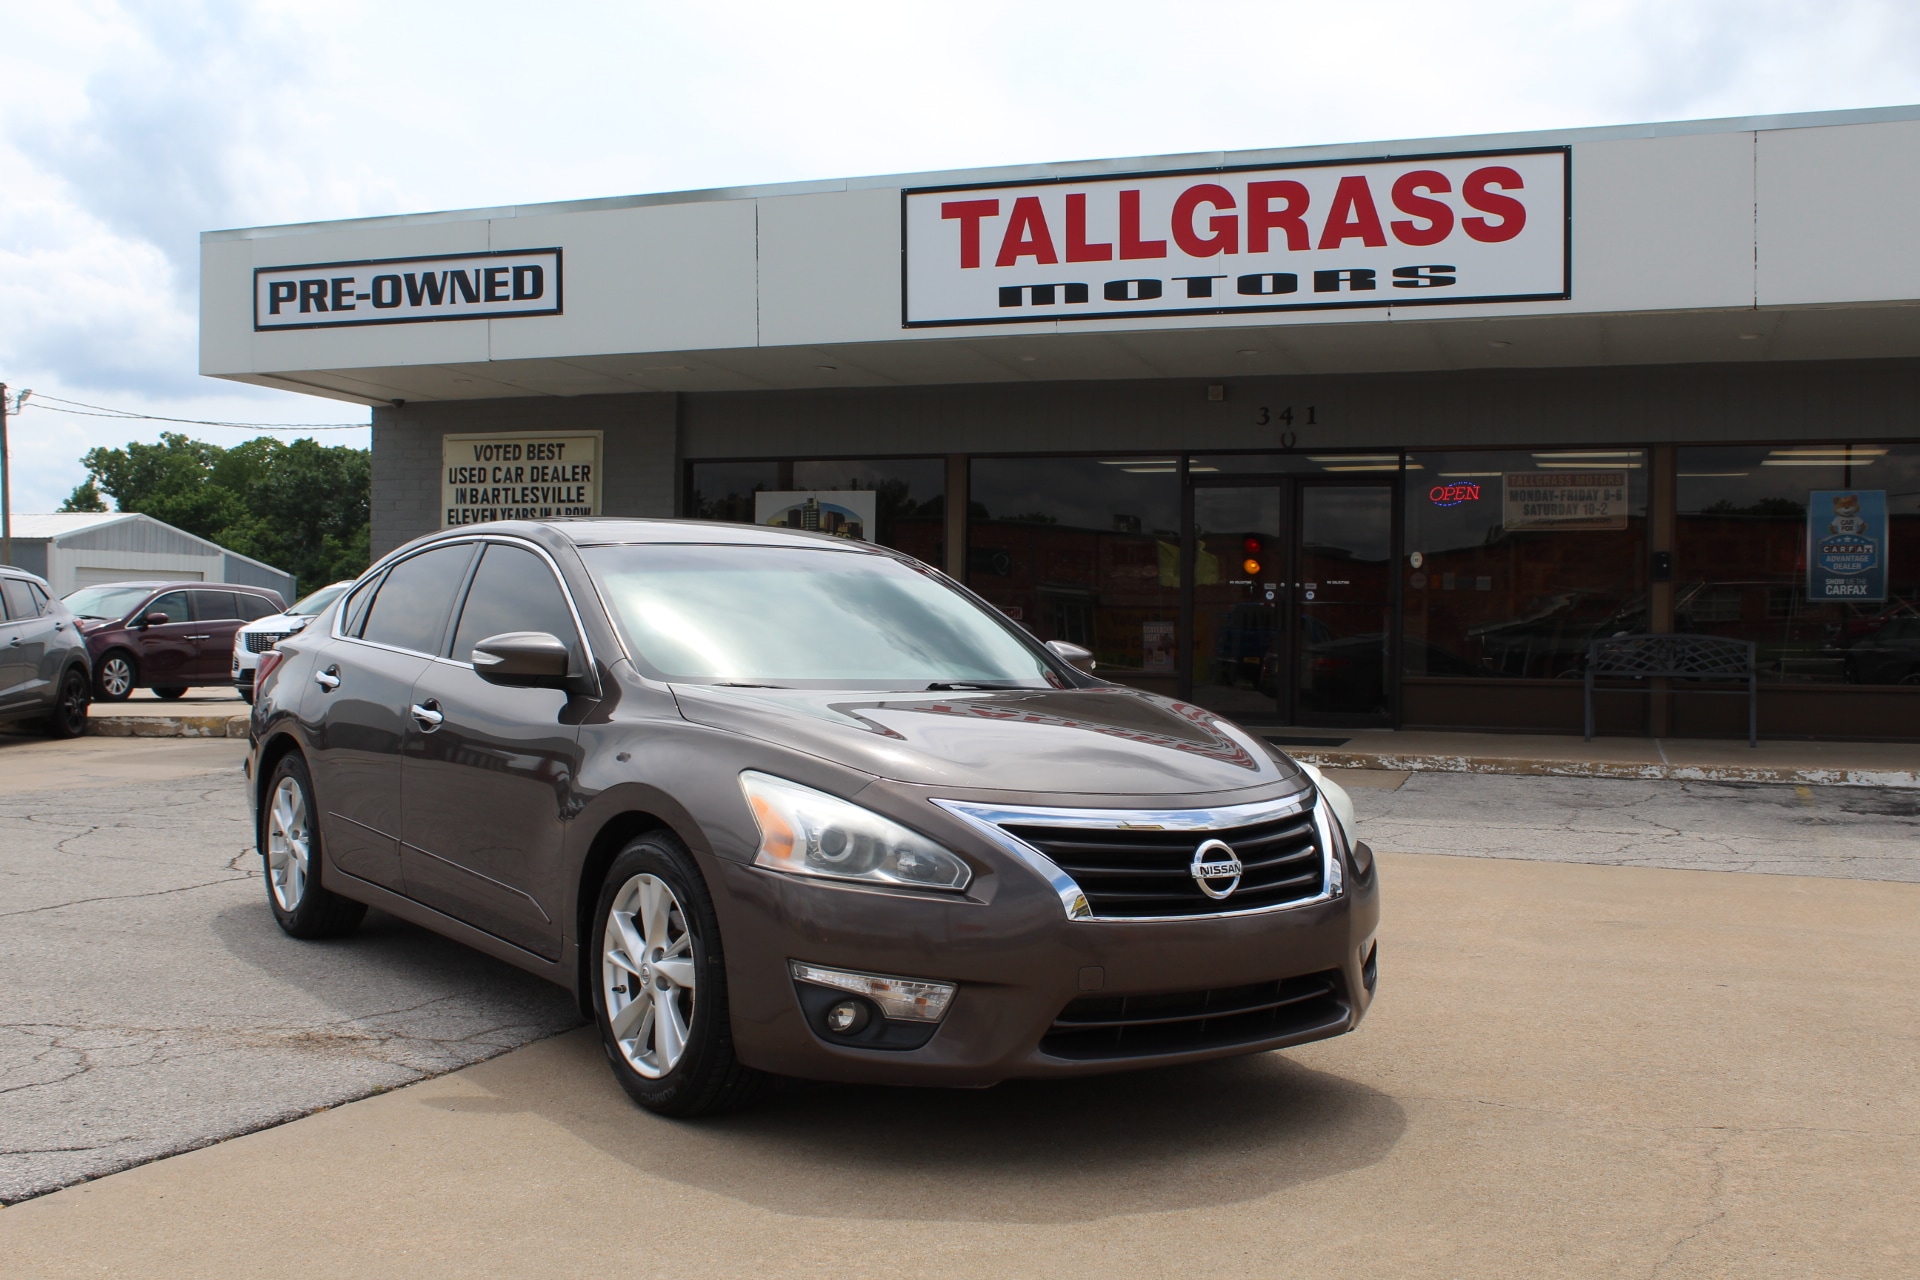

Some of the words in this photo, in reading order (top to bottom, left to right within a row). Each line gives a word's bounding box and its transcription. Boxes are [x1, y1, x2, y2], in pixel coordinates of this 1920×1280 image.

[941, 166, 1526, 269] TALLGRASS
[268, 264, 544, 315] PRE-OWNED
[998, 264, 1457, 308] MOTORS
[473, 443, 522, 461] VOTED
[526, 443, 565, 461] BEST
[449, 467, 487, 484] USED
[492, 466, 524, 484] CAR
[530, 465, 591, 482] DEALER
[1511, 475, 1572, 486] TALLGRASS
[1576, 474, 1623, 485] MOTORS
[455, 488, 467, 504] IN
[470, 486, 585, 504] BARTLESVILLE
[1429, 486, 1480, 501] OPEN
[1509, 489, 1598, 502] MONDAY-FRIDAY
[448, 508, 497, 525] ELEVEN
[500, 507, 537, 520] YEARS
[1523, 503, 1579, 516] SATURDAY
[1584, 503, 1608, 516] 10-2
[1823, 545, 1873, 554] CARFAX
[1826, 555, 1870, 563] ADVANTAGE
[1833, 562, 1862, 570] DEALER
[1825, 585, 1867, 595] CARFAX
[1200, 864, 1241, 875] NISSAN
